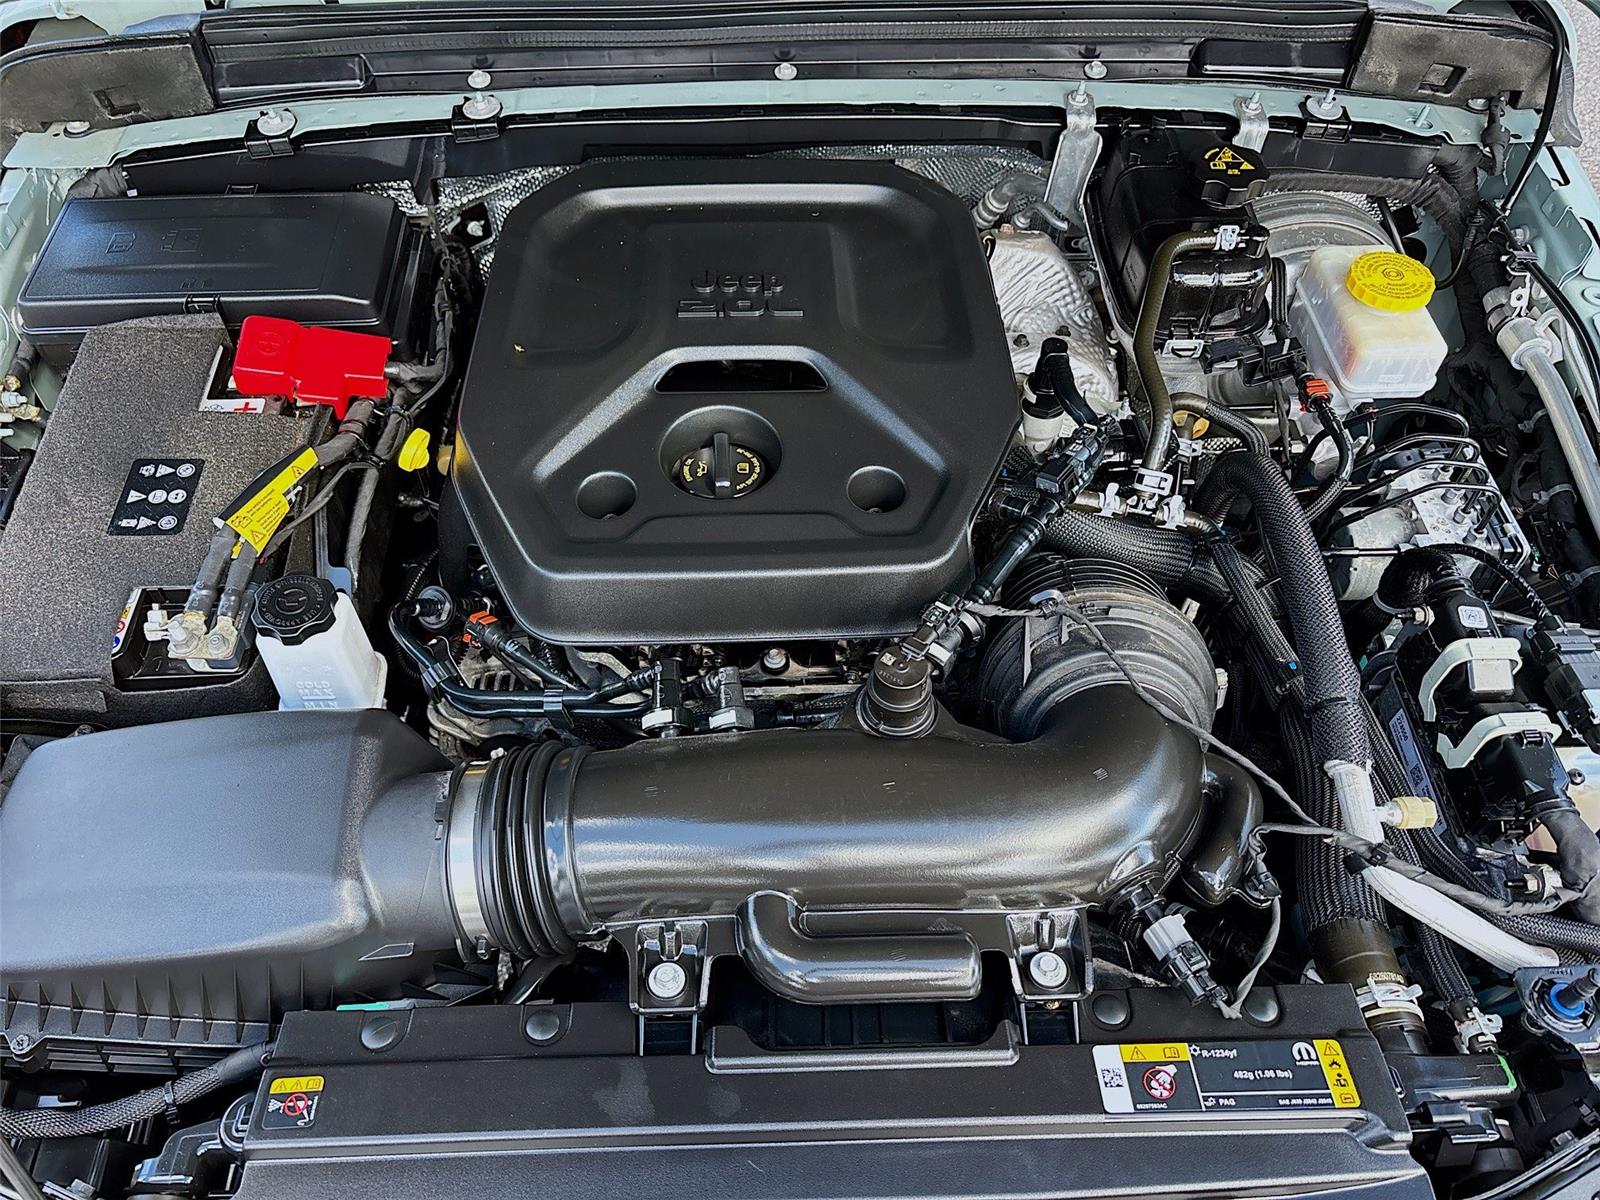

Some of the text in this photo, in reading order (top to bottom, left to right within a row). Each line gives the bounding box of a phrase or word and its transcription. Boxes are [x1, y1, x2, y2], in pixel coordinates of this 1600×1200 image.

[690, 270, 785, 296] Jeep
[677, 300, 804, 318] 2.0L
[296, 681, 331, 689] COLD
[1218, 1098, 1236, 1106] PAG
